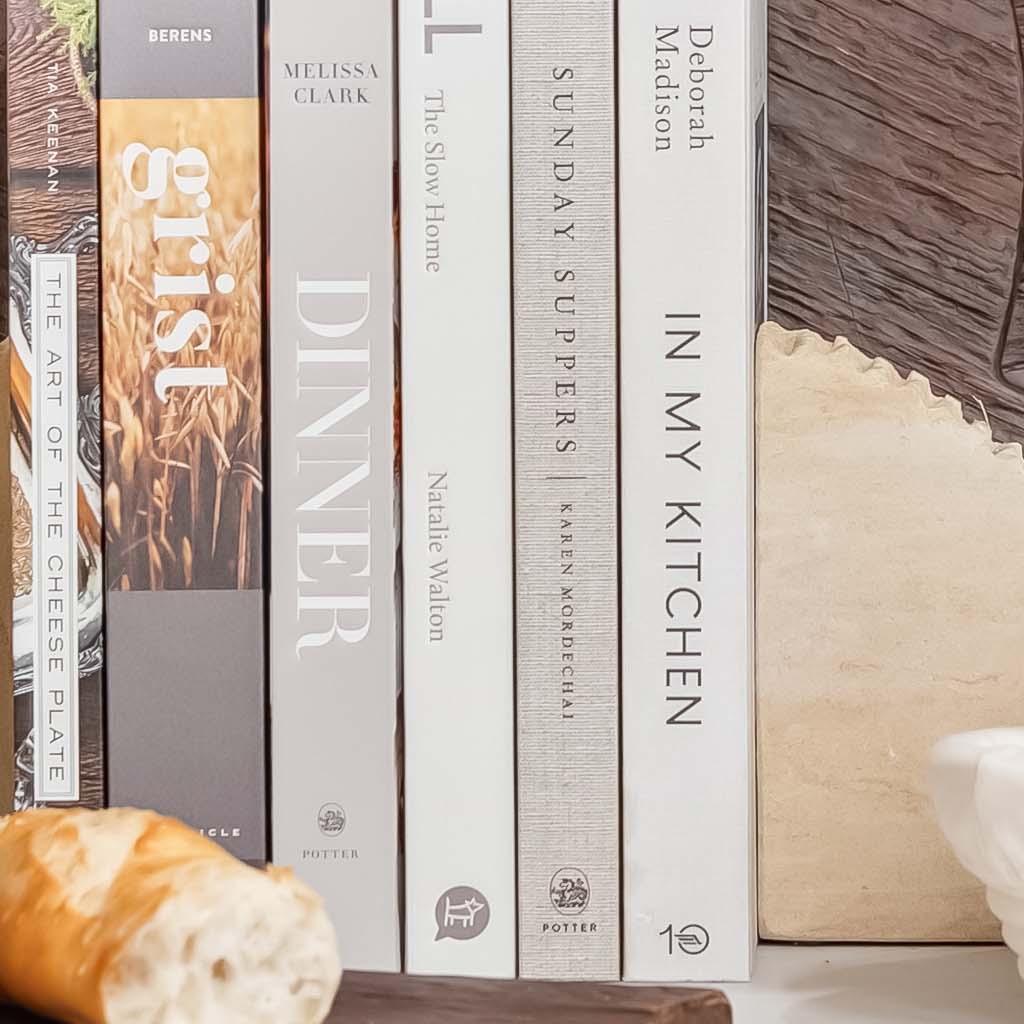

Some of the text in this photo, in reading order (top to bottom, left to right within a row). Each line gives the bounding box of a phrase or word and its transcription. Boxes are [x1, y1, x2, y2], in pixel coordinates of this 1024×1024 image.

[148, 28, 212, 43] BERENS
[284, 62, 379, 79] MELISSA
[293, 87, 370, 104] CLARK
[654, 24, 680, 152] Madison
[689, 24, 714, 151] Deborah
[47, 63, 60, 193] TIA KEENAN
[424, 89, 446, 273] The Slow Home
[122, 142, 228, 403] grist
[552, 66, 577, 454] SUNDAY SUPPERS
[46, 272, 65, 782] THE ART OF THE CHEESE PLATE
[297, 271, 372, 659] DINNER
[664, 313, 702, 726] IN MY KITCHEN
[427, 471, 450, 643] Natalie Walton
[559, 502, 574, 720] KAREN MORDECHAI
[302, 849, 360, 860] POTTER
[542, 922, 597, 933] POTTER
